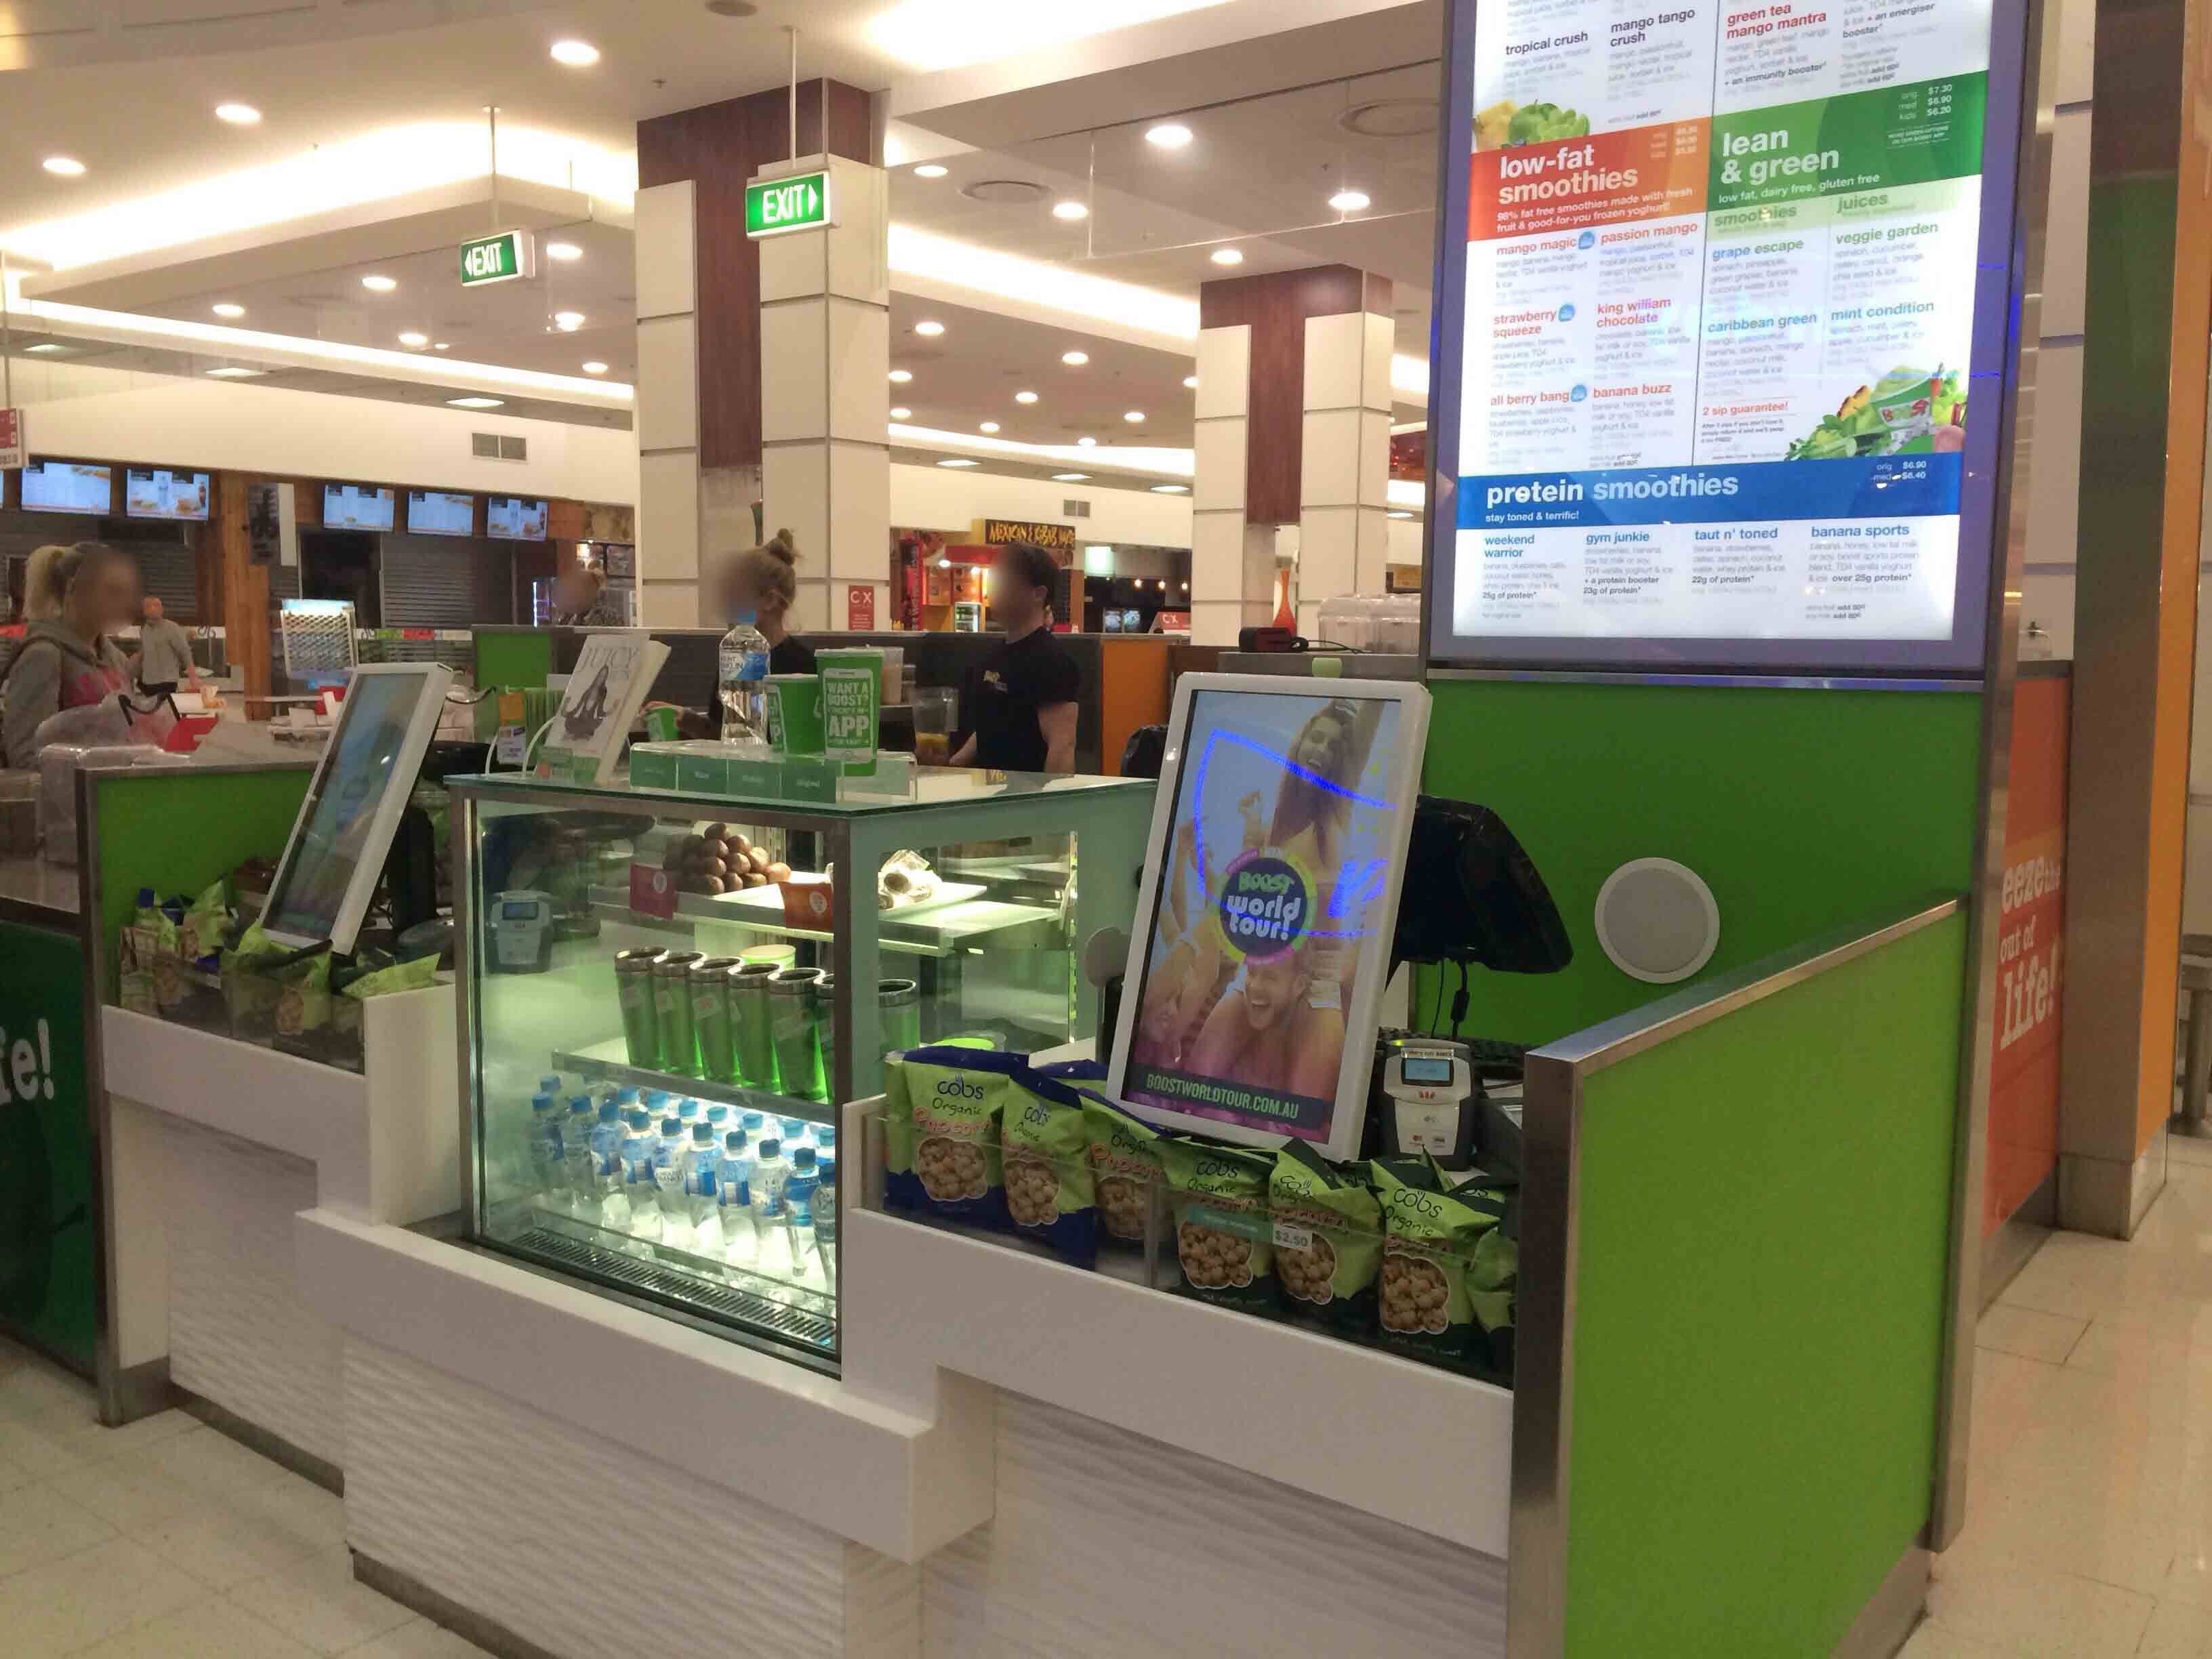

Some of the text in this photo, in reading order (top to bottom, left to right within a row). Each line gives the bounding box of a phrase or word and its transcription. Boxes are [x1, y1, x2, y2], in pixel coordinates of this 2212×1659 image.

[1611, 8, 1696, 34] mango tango
[1727, 4, 1791, 27] green tea
[1875, 12, 1887, 21] an
[1889, 3, 1936, 19] energiser
[1727, 12, 1826, 39] mango mantra
[1506, 30, 1589, 55] tropical crush
[1610, 31, 1646, 47] crush
[1746, 69, 1786, 82] immunity
[1722, 129, 1788, 157] lean
[1500, 144, 1595, 180] low-fat
[1721, 149, 1840, 186] & green
[1498, 168, 1639, 205] smoothies
[1719, 192, 1738, 204] low
[1761, 186, 1790, 201] dairy
[1819, 177, 1856, 192] gluten
[1857, 173, 1881, 186] free
[762, 184, 806, 224] EXIT
[1521, 208, 1534, 218] fat
[1536, 206, 1556, 217] free
[1557, 199, 1609, 214] smoothies
[1610, 194, 1639, 208] made
[1641, 190, 1664, 203] with
[1665, 187, 1693, 199] fresh
[1836, 192, 1888, 214] juices
[1496, 223, 1517, 234] fruit
[1518, 221, 1525, 230] &
[1527, 213, 1593, 230] good-for-you
[1593, 208, 1626, 223] frozen
[1714, 204, 1797, 227] smoothies
[1600, 222, 1698, 245] passion mango
[1836, 222, 1939, 245] veggie garden
[1496, 237, 1578, 256] mango magic
[1713, 239, 1804, 262] grape escape
[472, 242, 501, 276] EXIT
[1597, 297, 1671, 316] king william
[1830, 301, 1935, 321] mint condition
[1494, 310, 1557, 326] strawberry
[1596, 312, 1658, 329] chocolate
[1708, 312, 1818, 333] caribbean green
[1493, 325, 1542, 340] squeeze
[1490, 390, 1570, 407] all berry bang
[1593, 382, 1673, 399] banana buzz
[1702, 401, 1788, 417] 2 sip guarantee!
[1902, 460, 1927, 470] $6.90
[1486, 472, 1739, 509] protein smoothies
[1486, 510, 1580, 524] stay toned & terrific!
[1485, 534, 1535, 546] weekend
[1586, 531, 1650, 546] gym junkie
[1694, 529, 1719, 540] taut
[1740, 527, 1778, 539] toned
[1811, 525, 1910, 539] banana sports
[1484, 548, 1524, 558] warrior
[1598, 576, 1626, 586] protein
[1628, 575, 1660, 584] booster
[1691, 575, 1708, 585] 22g
[1708, 575, 1719, 583] of
[1832, 575, 1853, 583] over
[1855, 574, 1872, 583] 25g
[1497, 591, 1506, 599] of
[1583, 586, 1599, 596] 23g
[1599, 586, 1608, 594] of
[827, 682, 869, 695] WANT A
[827, 694, 869, 707] BOOST?
[829, 715, 869, 737] APP
[1237, 871, 1291, 895] BOOST
[1227, 895, 1302, 922] world
[1229, 910, 1290, 941] tour!
[2000, 914, 2037, 965] out of
[937, 1076, 984, 1100] cobs
[1145, 1073, 1300, 1119] BOOSTWORLDTOUR.COM.AU
[932, 1097, 982, 1117] Organic
[1196, 1160, 1241, 1179] cobs
[1187, 1178, 1237, 1193] Organic
[1393, 1187, 1443, 1219] cobs
[1385, 1204, 1433, 1237] Organic
[1274, 1229, 1309, 1248] $2.50
